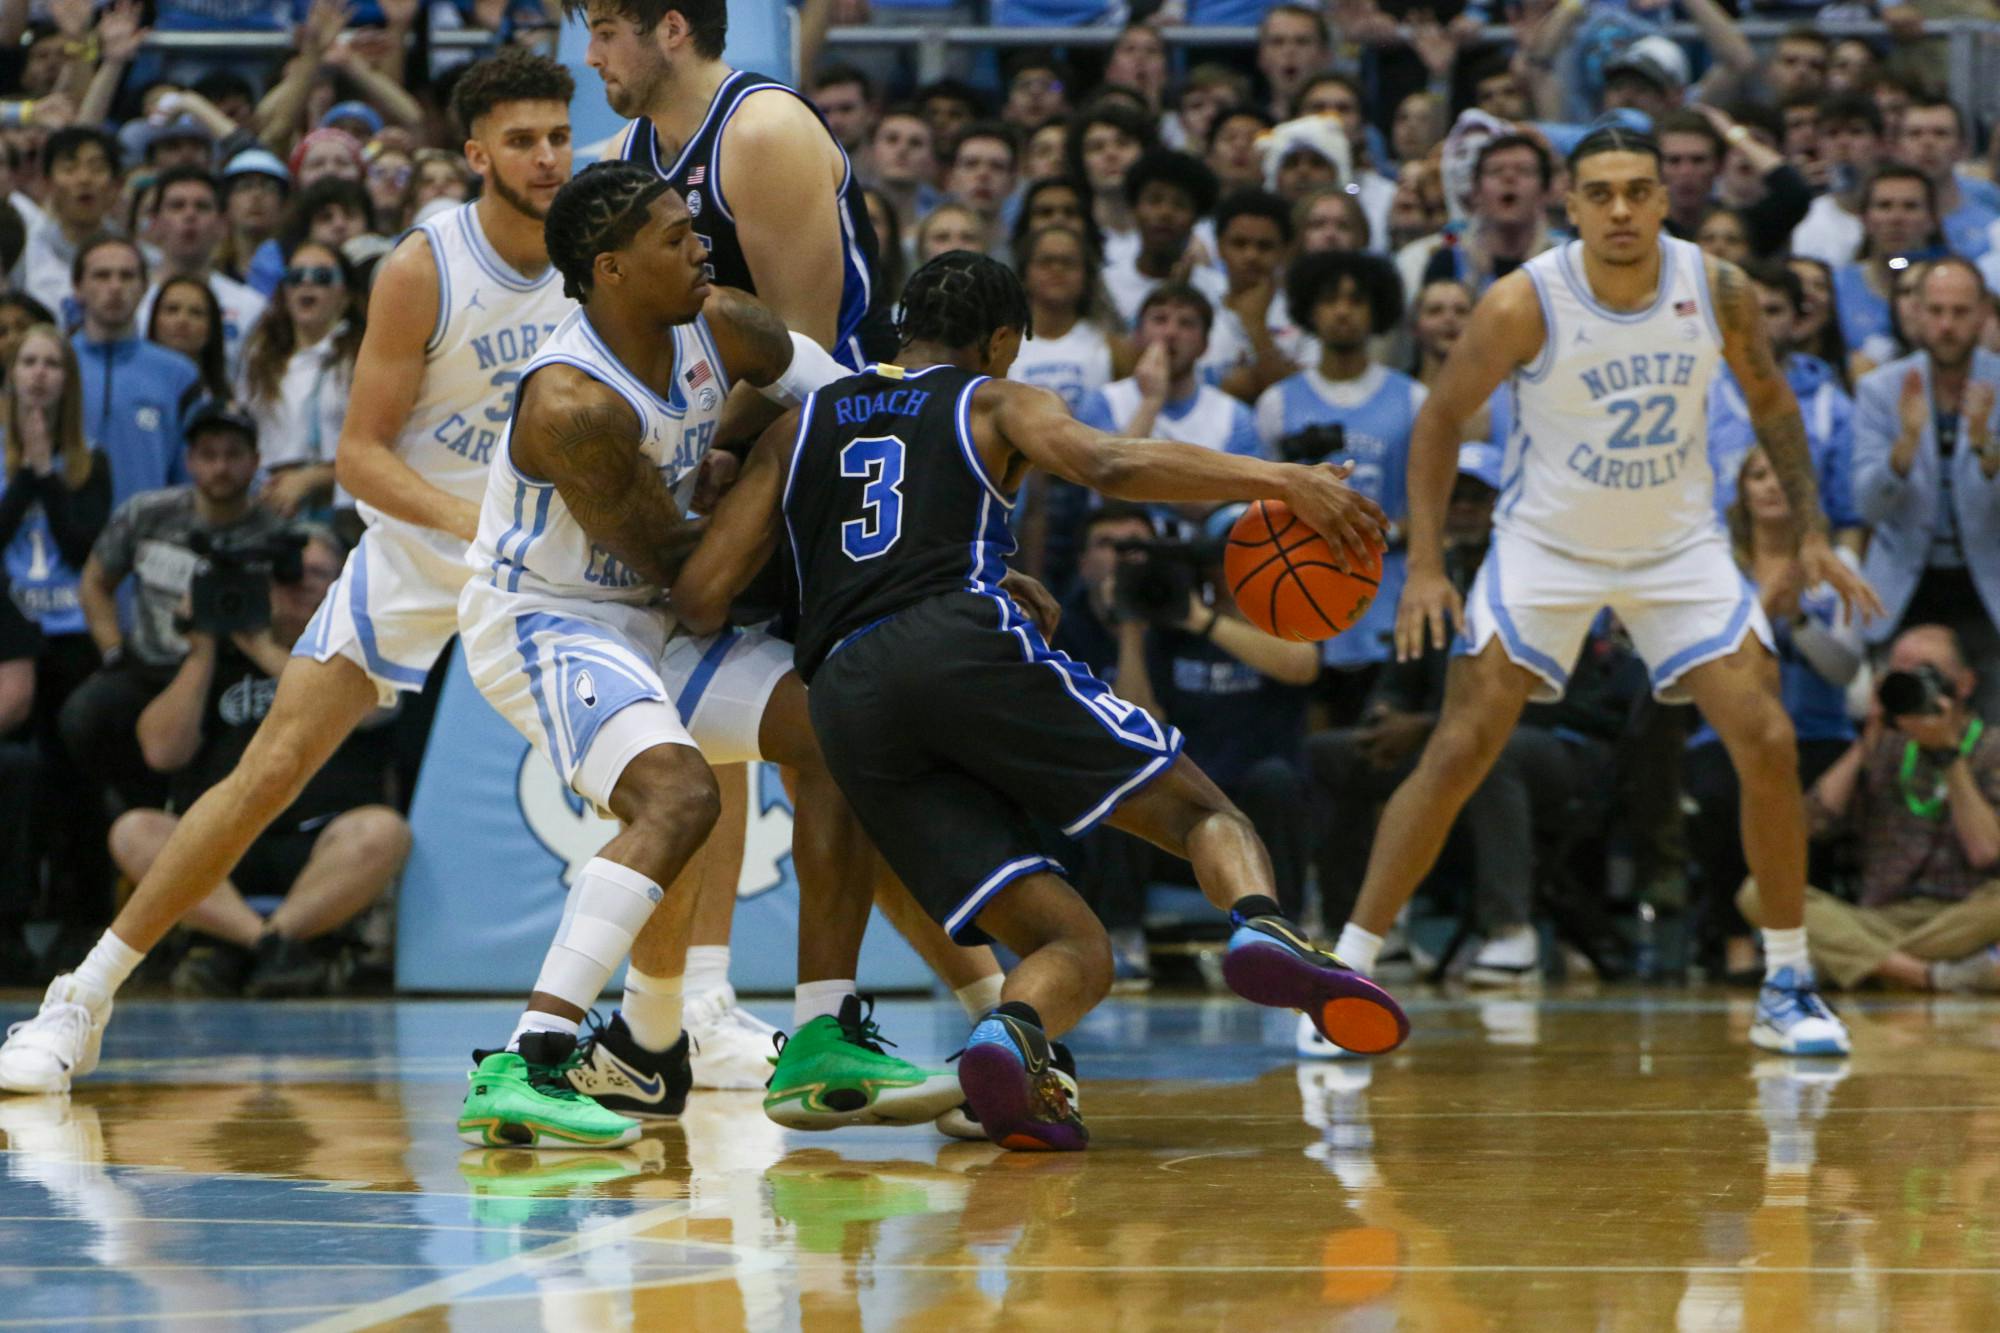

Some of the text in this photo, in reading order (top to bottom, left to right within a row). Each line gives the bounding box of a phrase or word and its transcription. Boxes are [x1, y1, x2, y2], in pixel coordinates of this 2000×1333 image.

[1579, 352, 1696, 400] NORTH
[835, 388, 930, 426] ROACH
[1606, 394, 1677, 449] 22
[434, 412, 500, 465] CAR
[840, 435, 906, 562] 3
